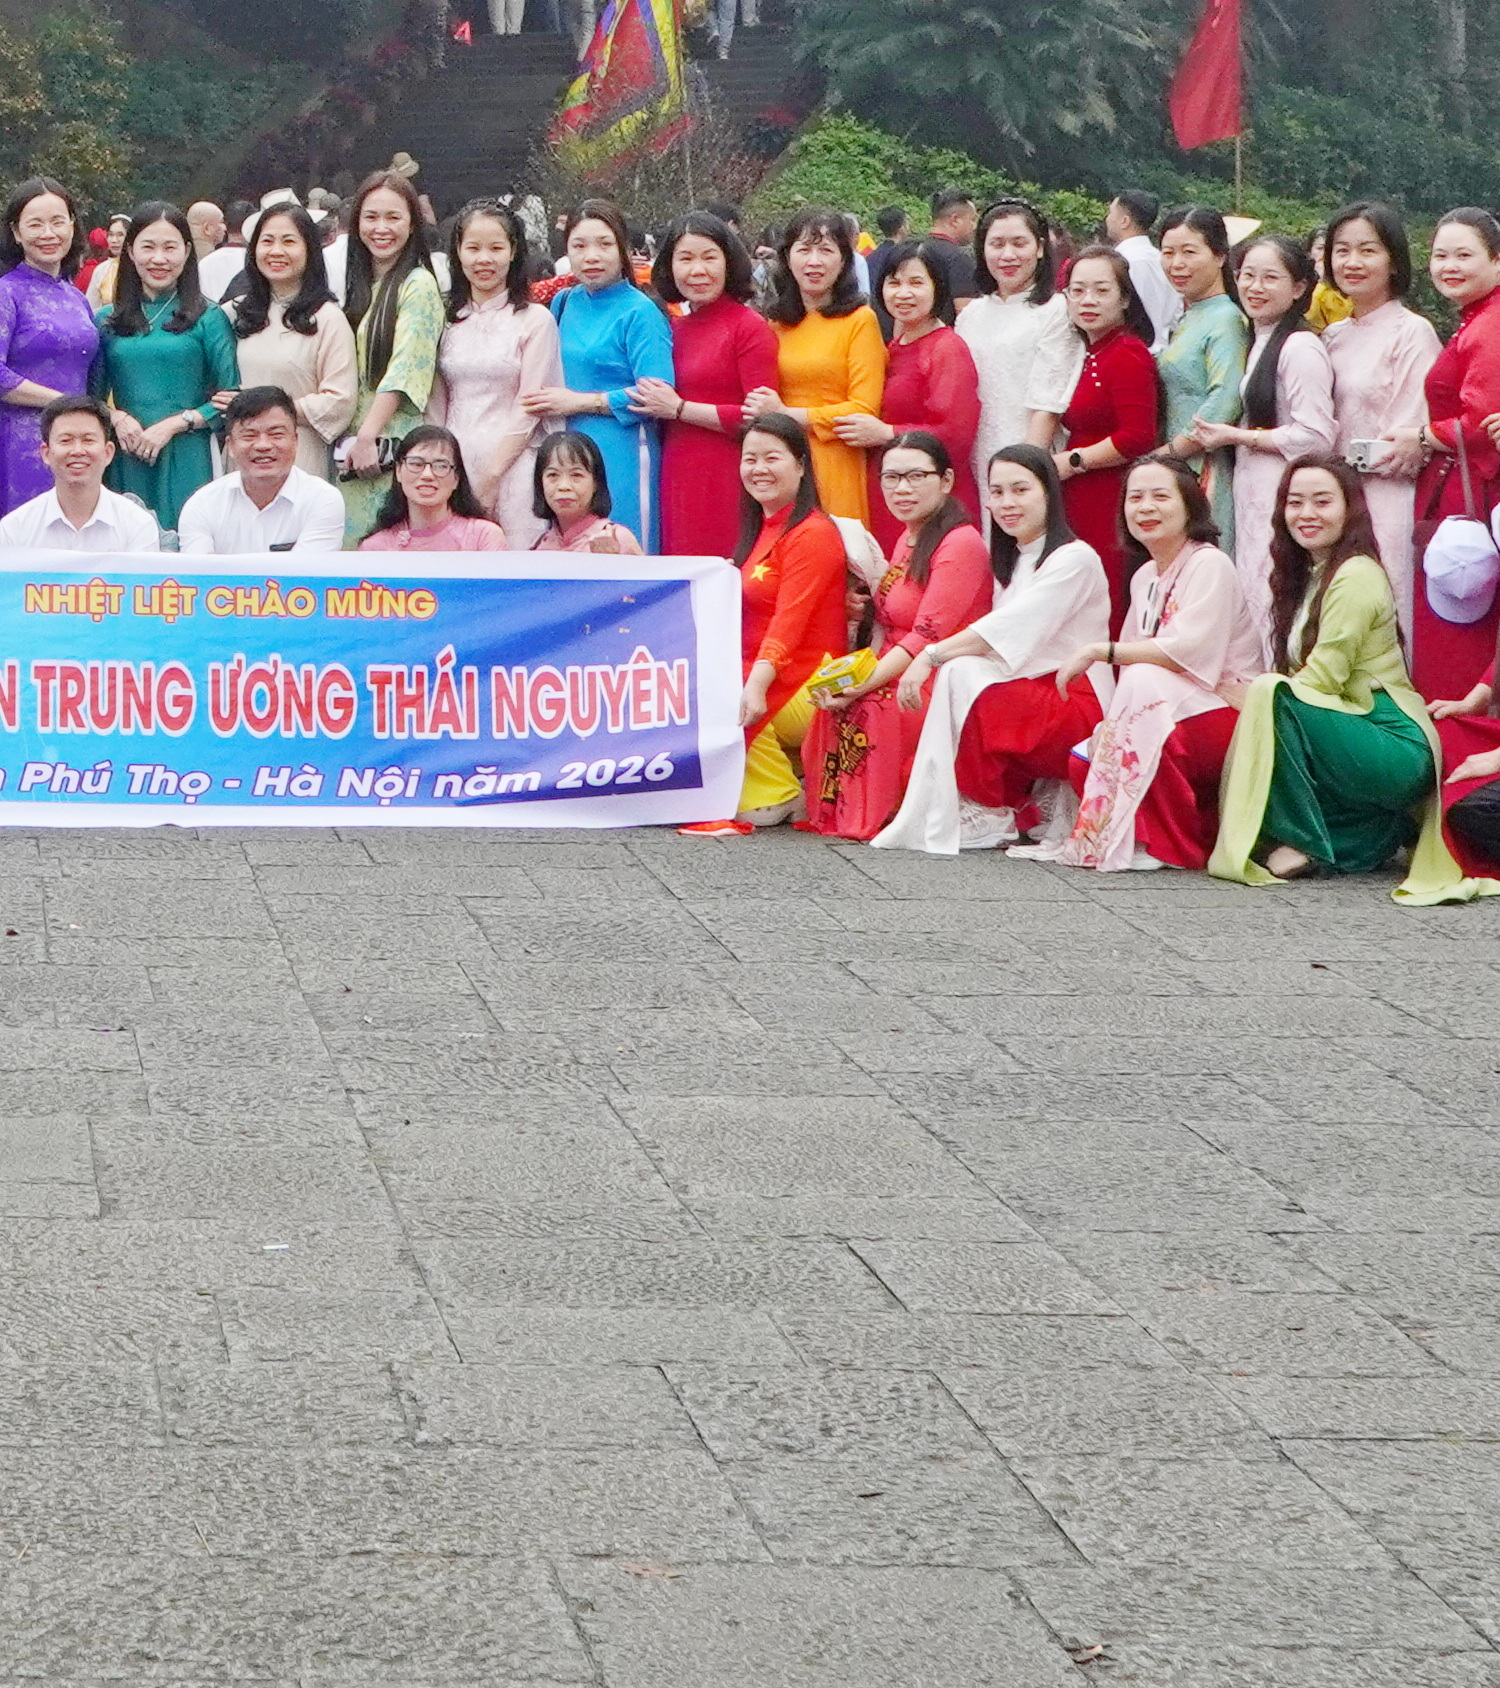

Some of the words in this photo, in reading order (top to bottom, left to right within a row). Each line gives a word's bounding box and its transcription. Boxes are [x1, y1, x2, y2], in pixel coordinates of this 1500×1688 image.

[25, 577, 125, 622] NHIỆT
[133, 578, 198, 623] LIỆT
[205, 578, 317, 619] CHÀO
[325, 579, 438, 620] MỪNG
[30, 657, 196, 738] TRUNG
[207, 650, 357, 740] ƯƠNG
[366, 643, 479, 740] THÁI
[491, 644, 690, 740] NGUYÊN
[17, 759, 111, 795] Phú
[125, 763, 212, 804] Thọ
[252, 763, 324, 799] Hà
[338, 765, 422, 806] Nội
[432, 765, 542, 800] năm
[554, 751, 676, 791] 2026
